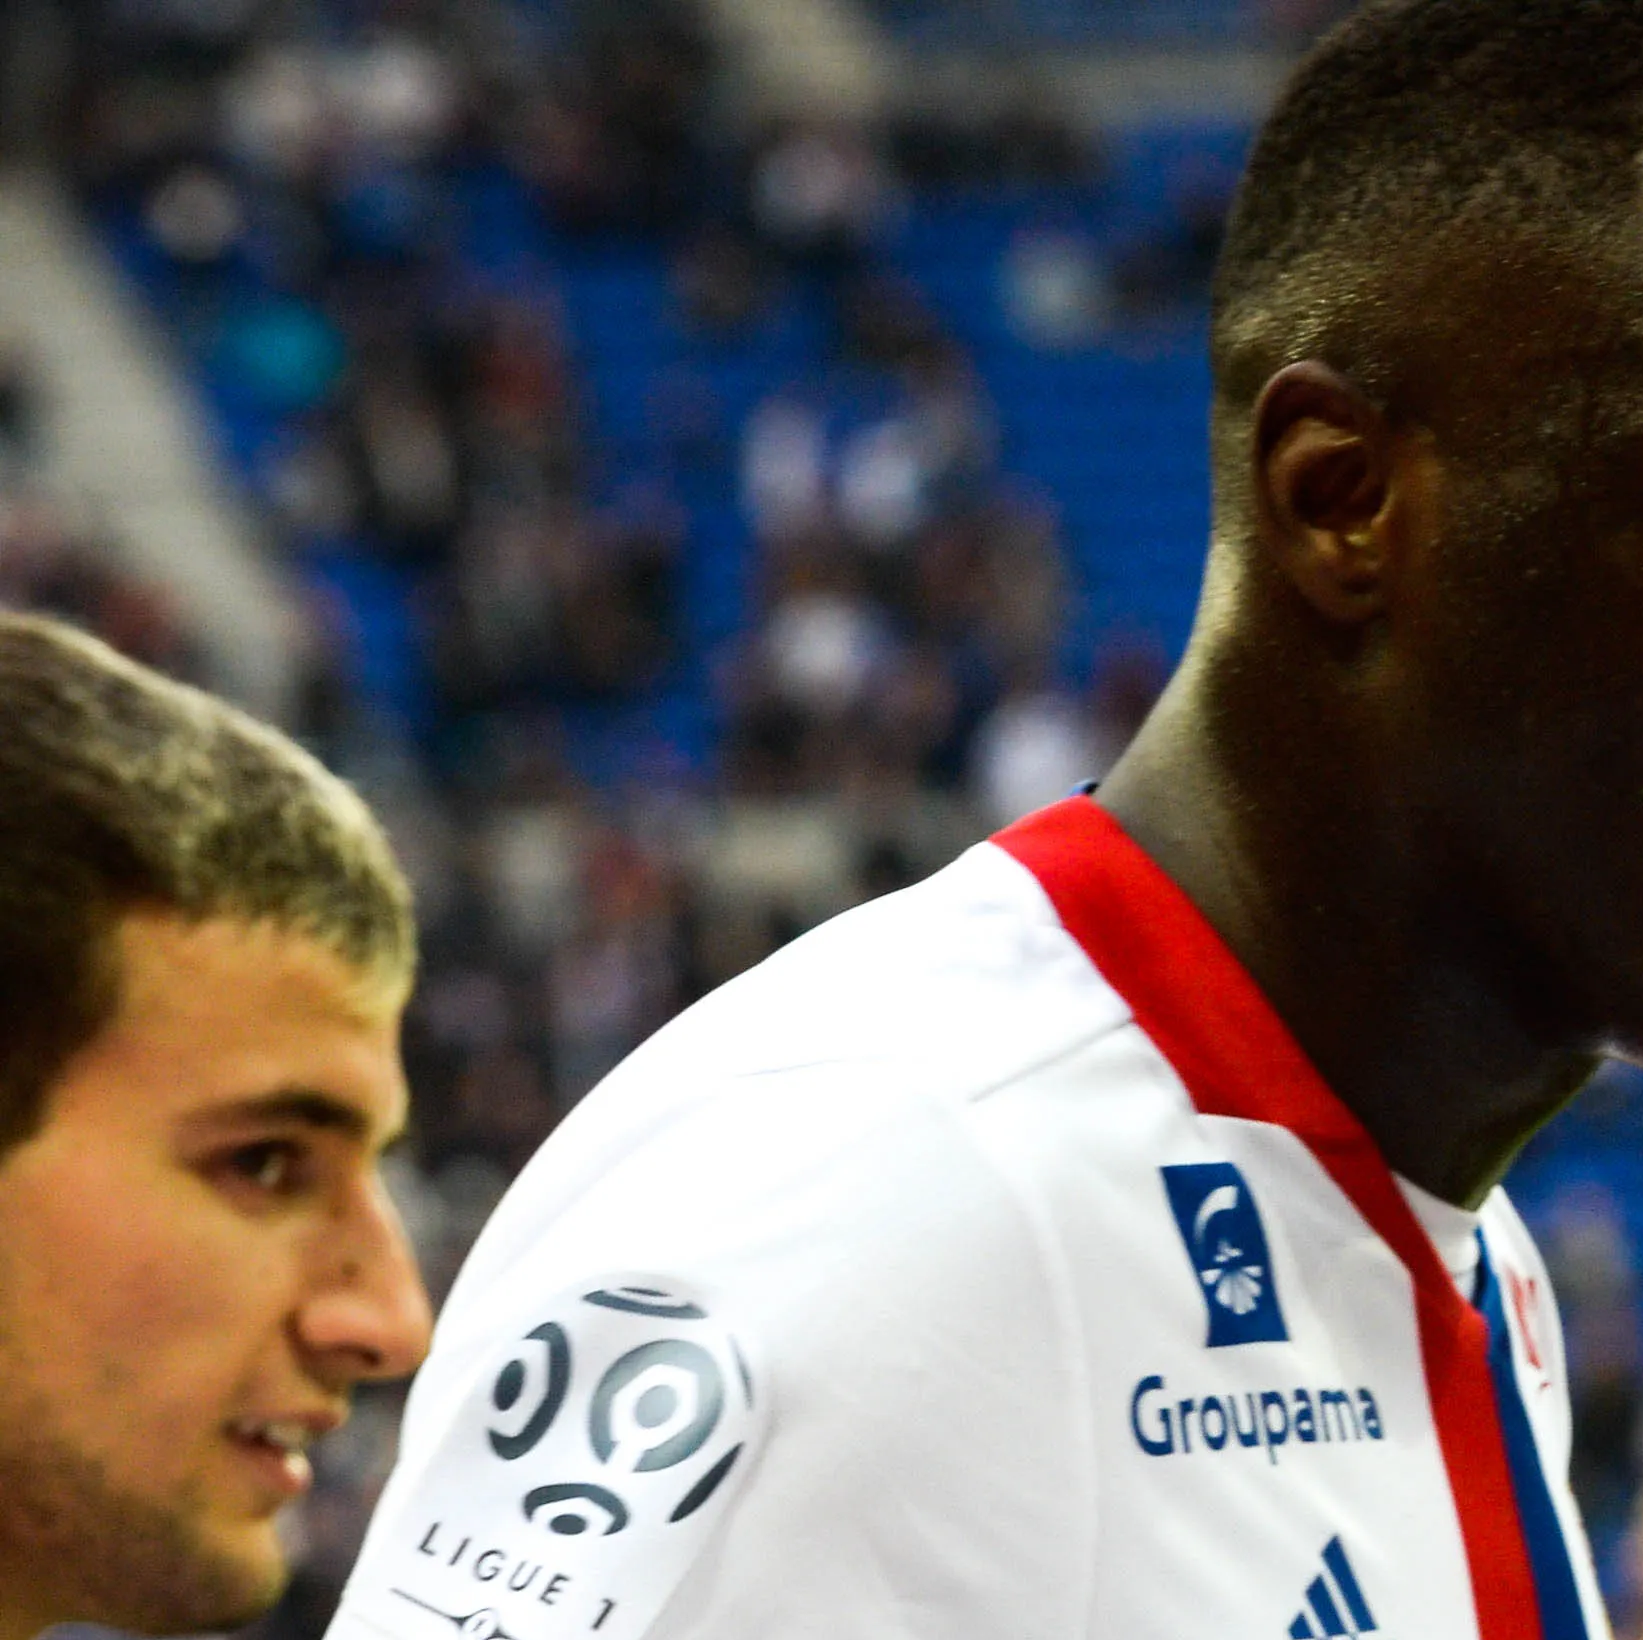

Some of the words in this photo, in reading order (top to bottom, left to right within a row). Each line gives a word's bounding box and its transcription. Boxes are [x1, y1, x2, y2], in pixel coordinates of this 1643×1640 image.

[1129, 1374, 1386, 1466] Groupama
[416, 1520, 574, 1606] LIGUE
[590, 1597, 619, 1633] 1
